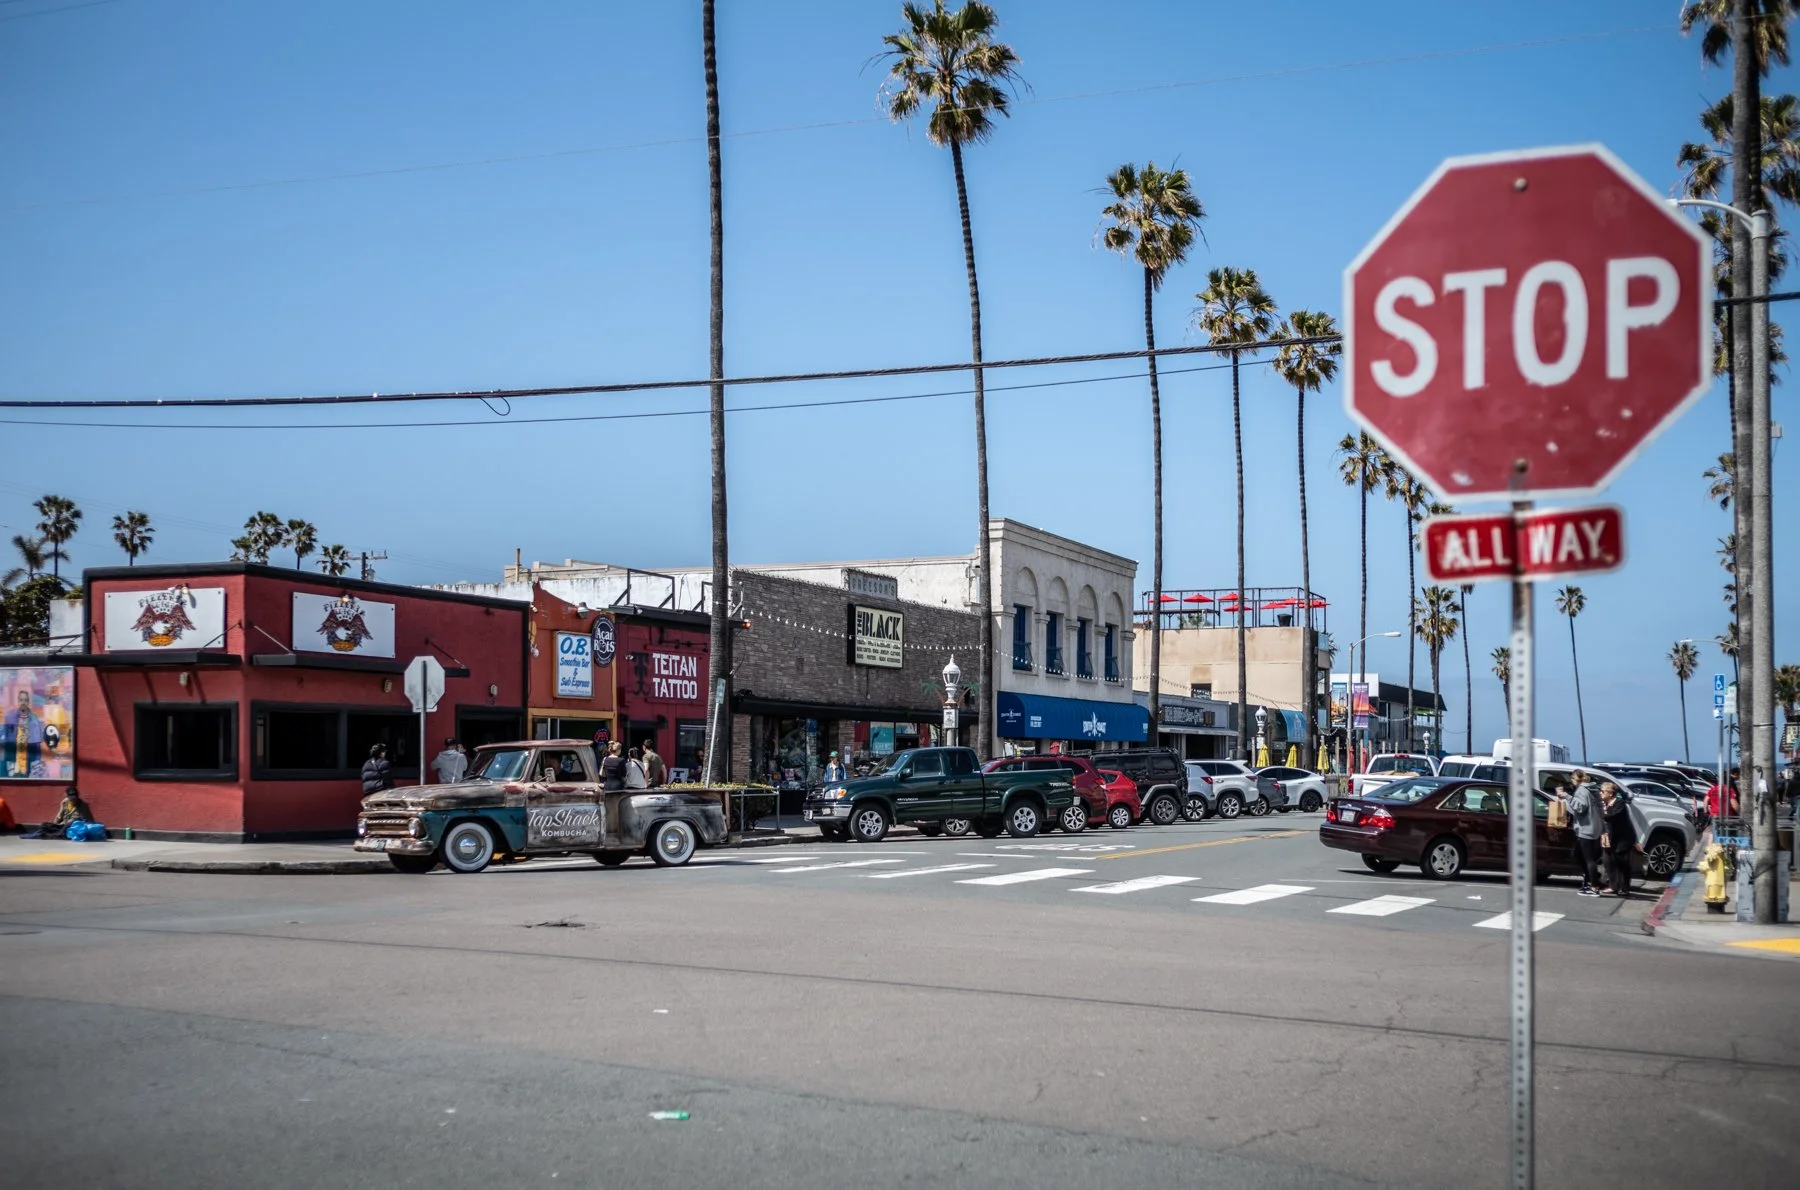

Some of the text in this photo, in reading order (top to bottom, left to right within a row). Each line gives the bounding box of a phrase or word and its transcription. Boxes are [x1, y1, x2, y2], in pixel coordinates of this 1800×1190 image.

[1370, 256, 1681, 398] STOP
[1440, 519, 1607, 570] ALL WAY
[862, 611, 901, 641] BLACK
[560, 636, 589, 656] O.B.
[652, 652, 697, 677] TEITAN
[652, 677, 698, 700] TATTOO
[541, 829, 587, 837] KOMBUCHA
